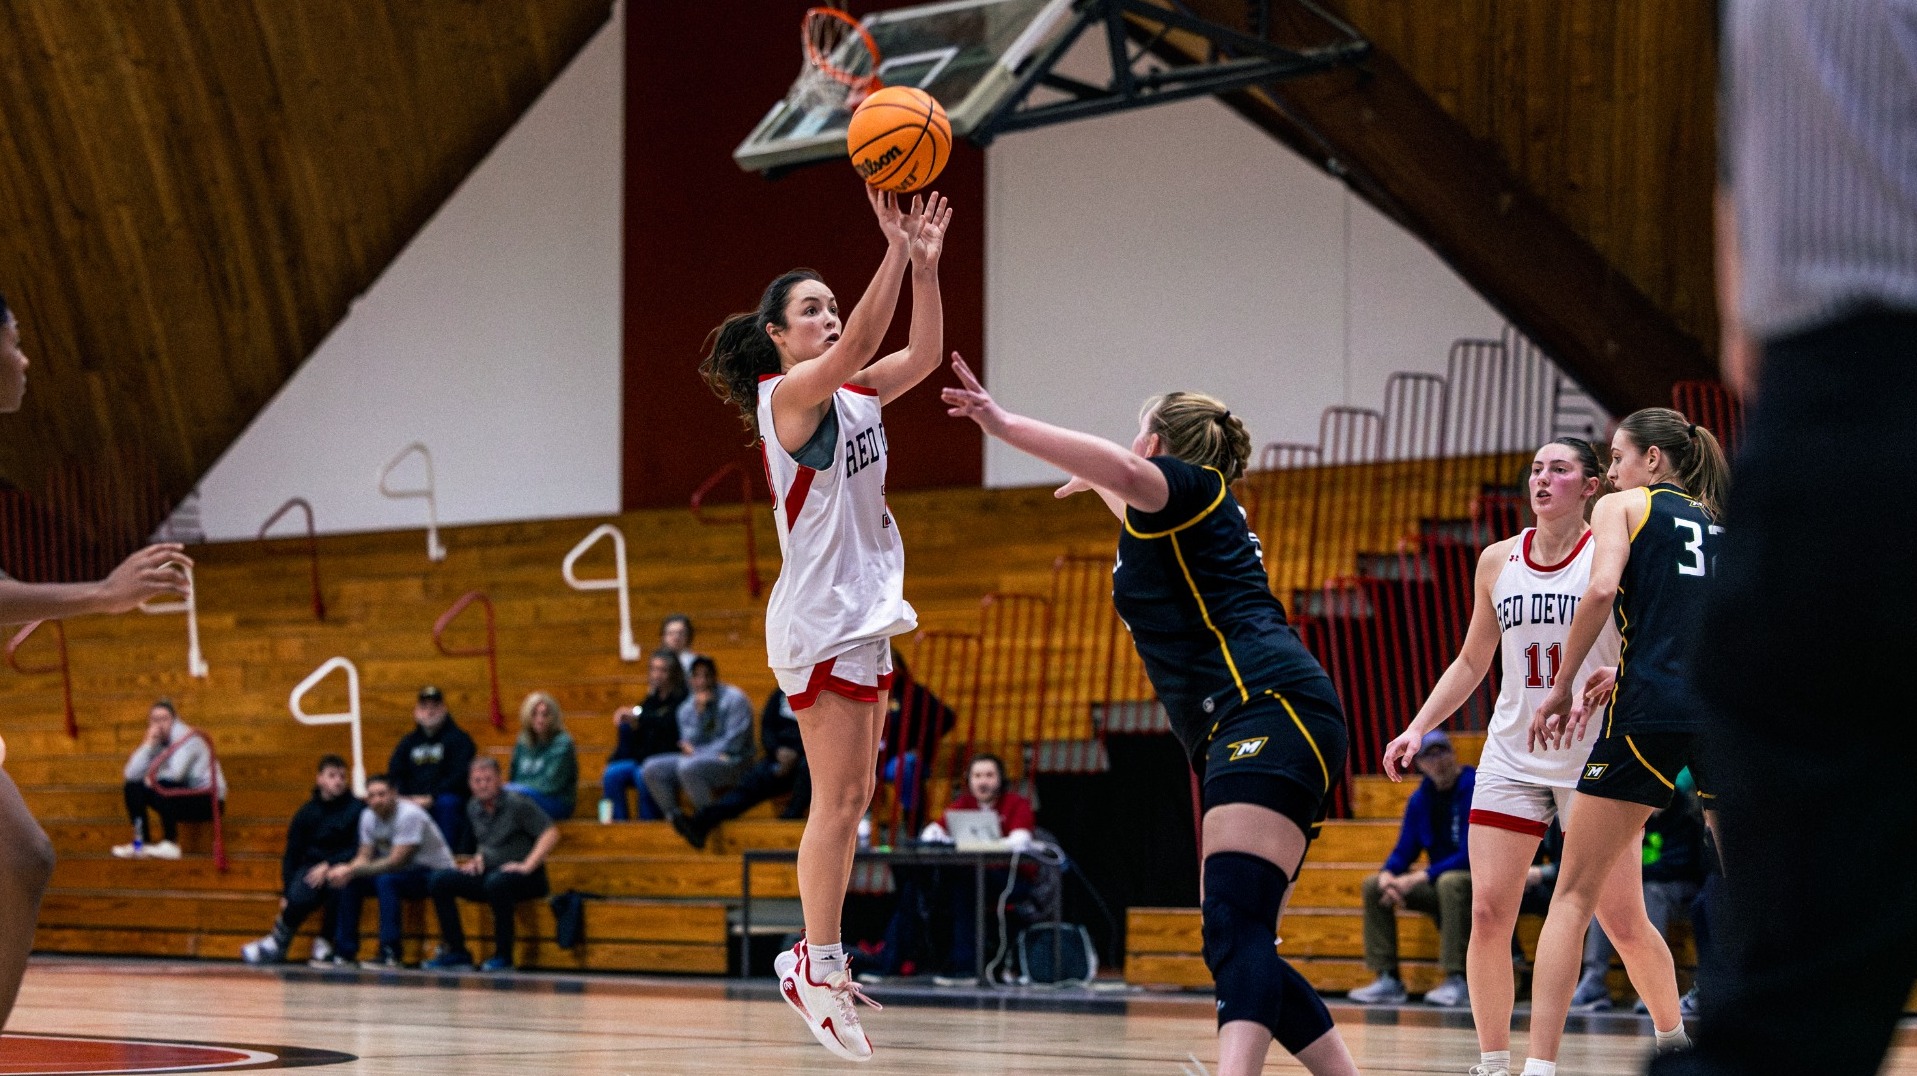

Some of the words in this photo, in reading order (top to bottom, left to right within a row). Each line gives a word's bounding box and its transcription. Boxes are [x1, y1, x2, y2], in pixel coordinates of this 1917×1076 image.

[846, 426, 880, 478] RED
[1530, 593, 1581, 627] DEVI
[1525, 642, 1562, 689] 11
[1236, 740, 1262, 756] M
